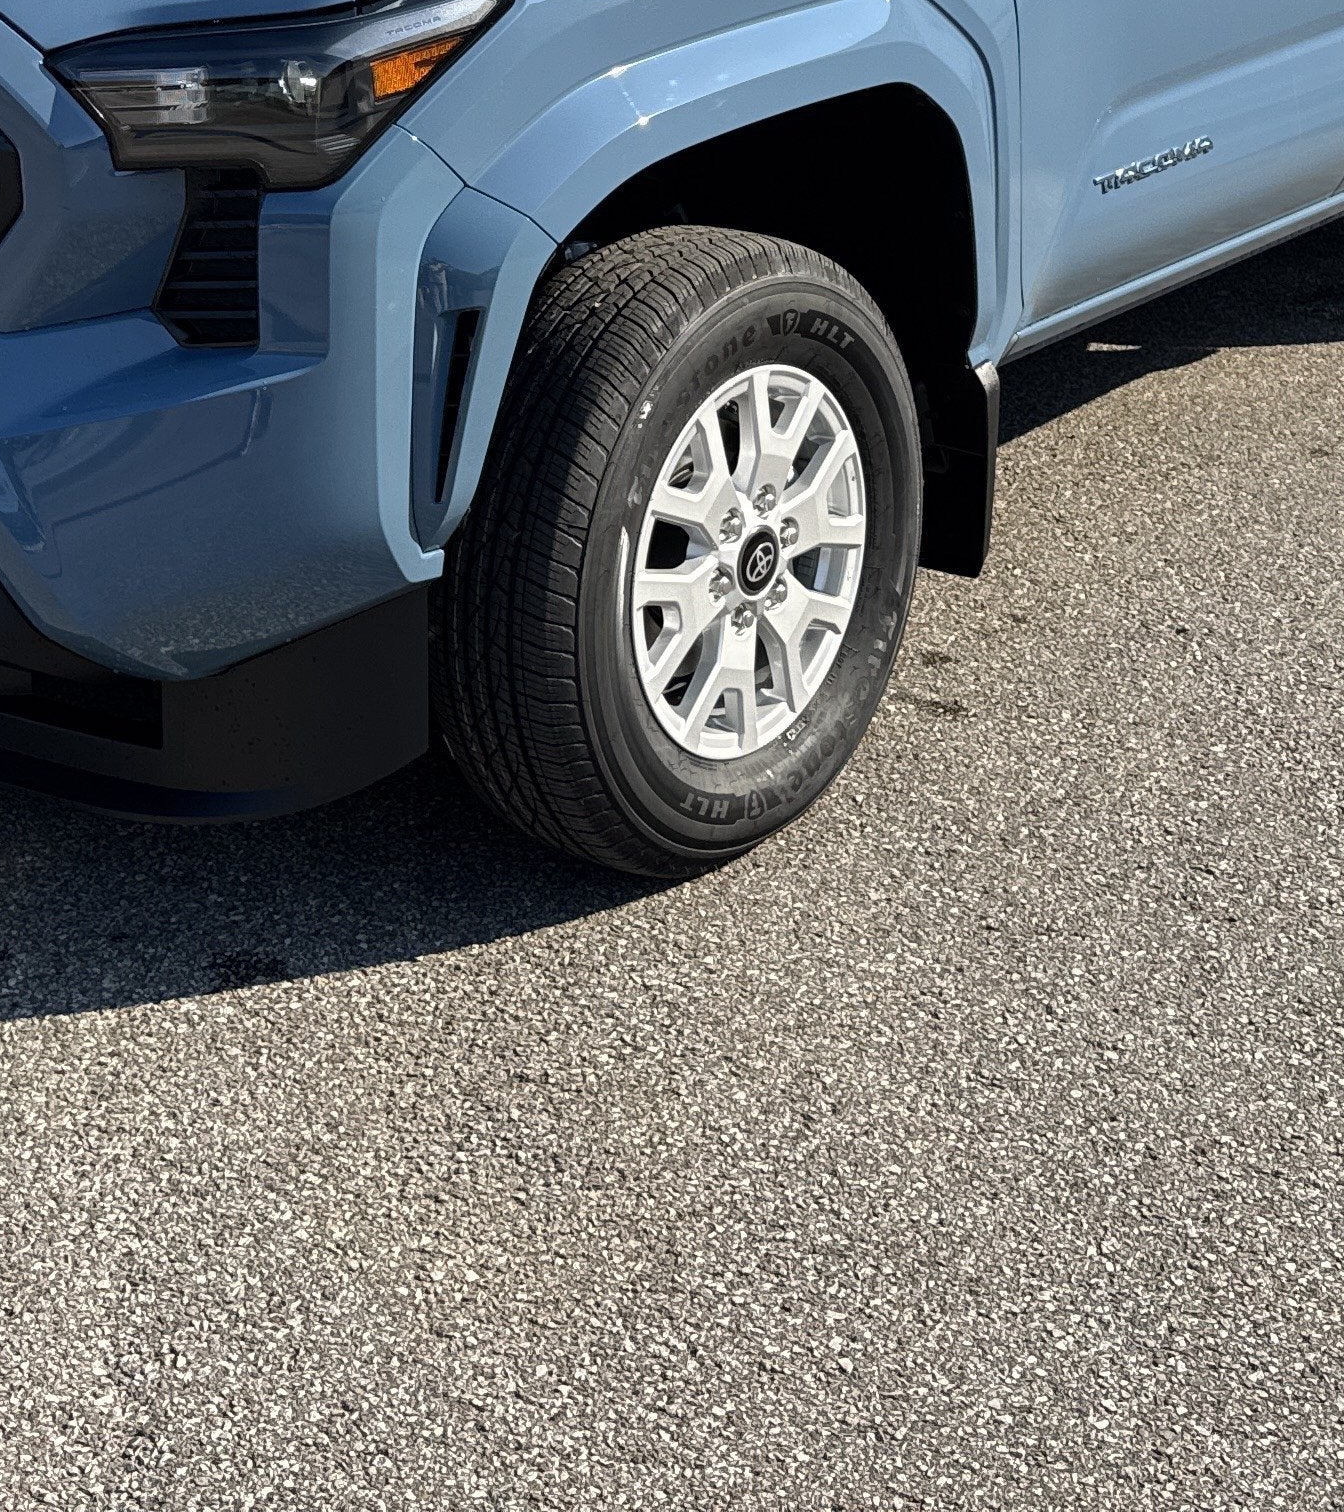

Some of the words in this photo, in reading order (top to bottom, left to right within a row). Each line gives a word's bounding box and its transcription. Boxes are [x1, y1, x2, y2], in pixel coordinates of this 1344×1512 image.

[386, 15, 442, 36] TACOMA
[1092, 135, 1214, 195] TACOMA
[809, 317, 855, 349] HLT
[679, 792, 731, 819] HLT
